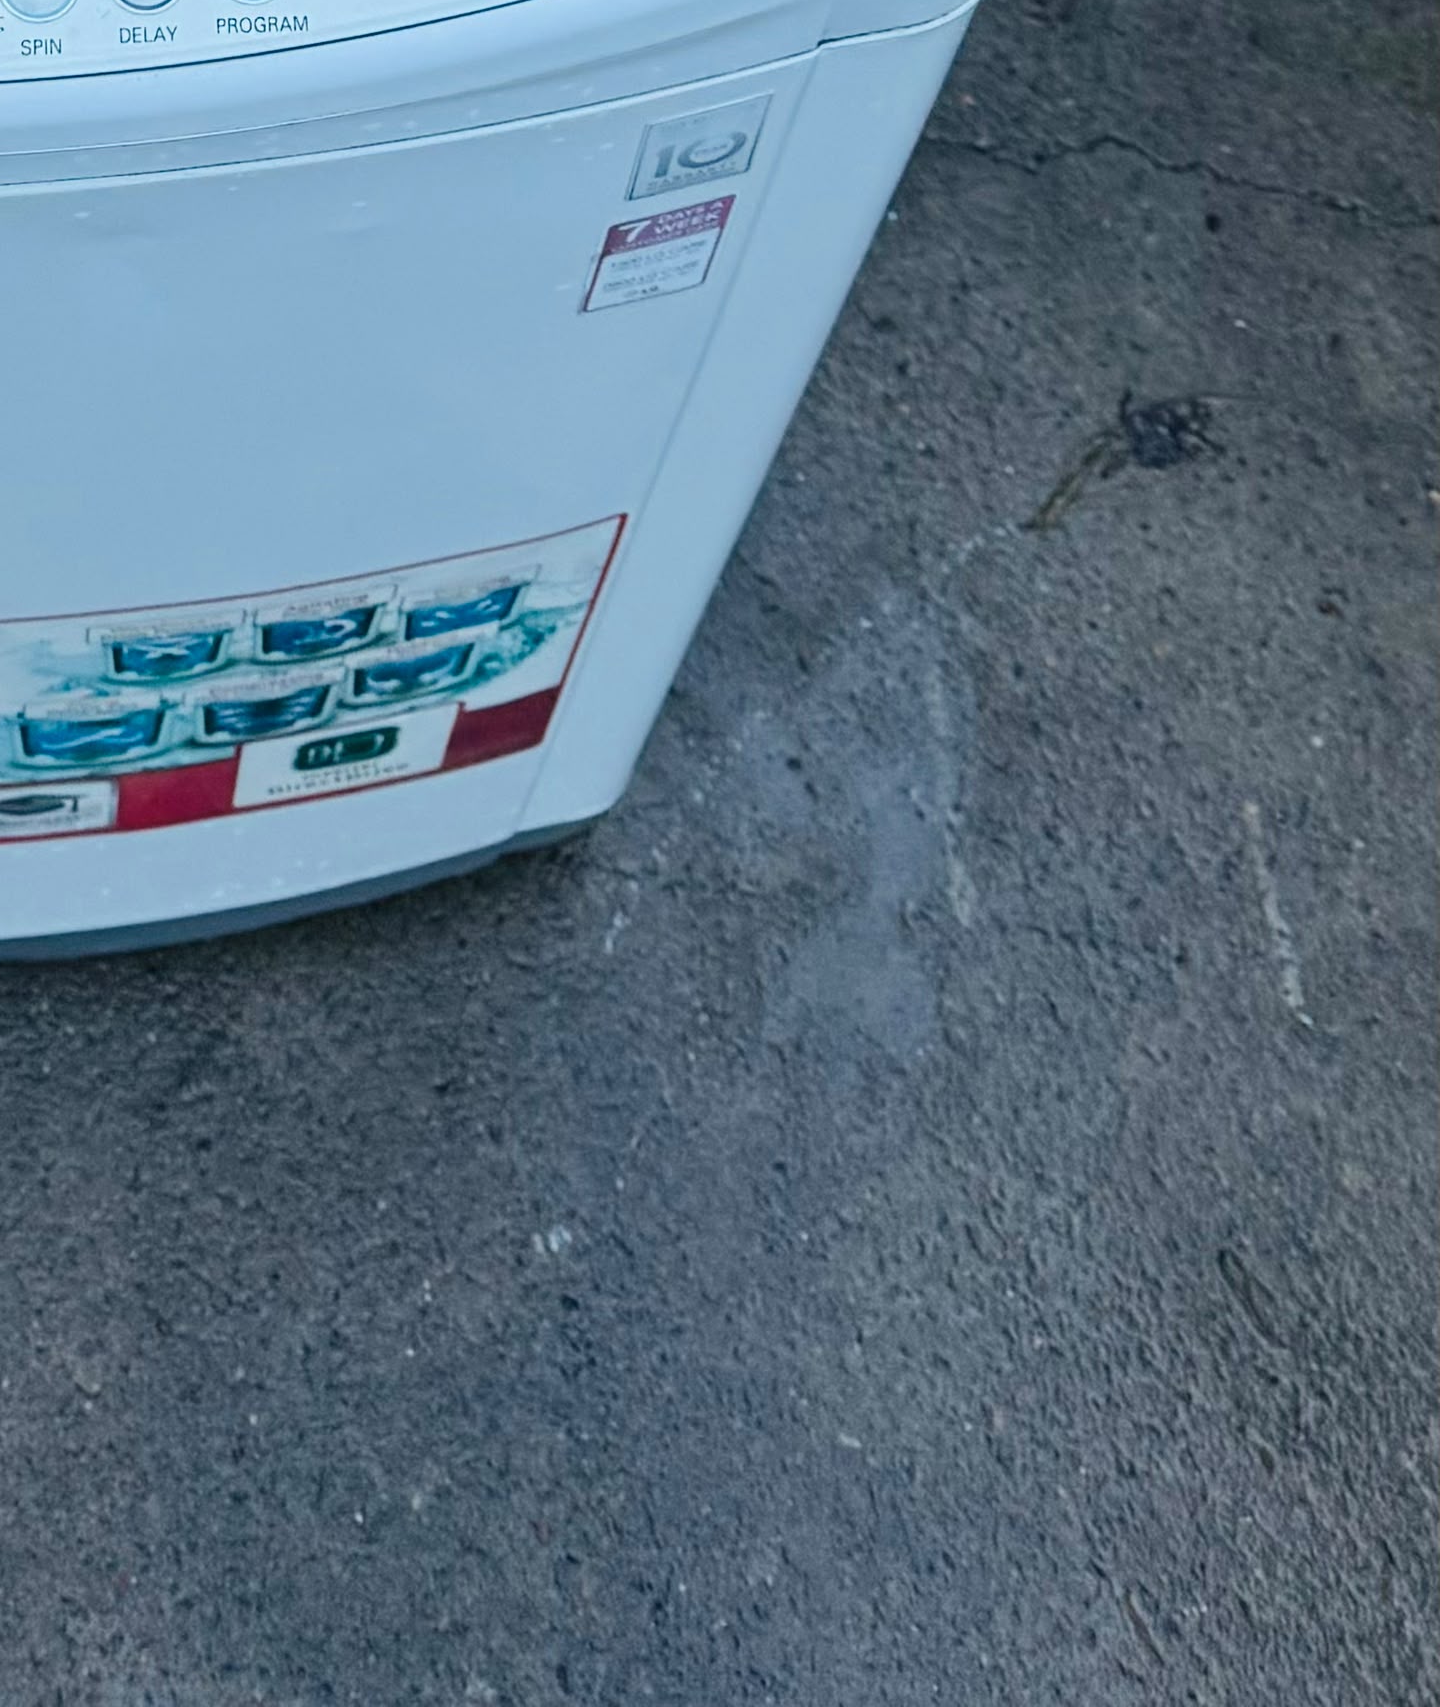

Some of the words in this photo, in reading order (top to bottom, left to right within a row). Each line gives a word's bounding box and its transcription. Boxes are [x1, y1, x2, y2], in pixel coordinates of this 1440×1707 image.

[216, 15, 309, 34] PROGRAM
[119, 25, 178, 45] DELAY
[20, 38, 63, 57] SPIN
[655, 211, 720, 235] WEEK
